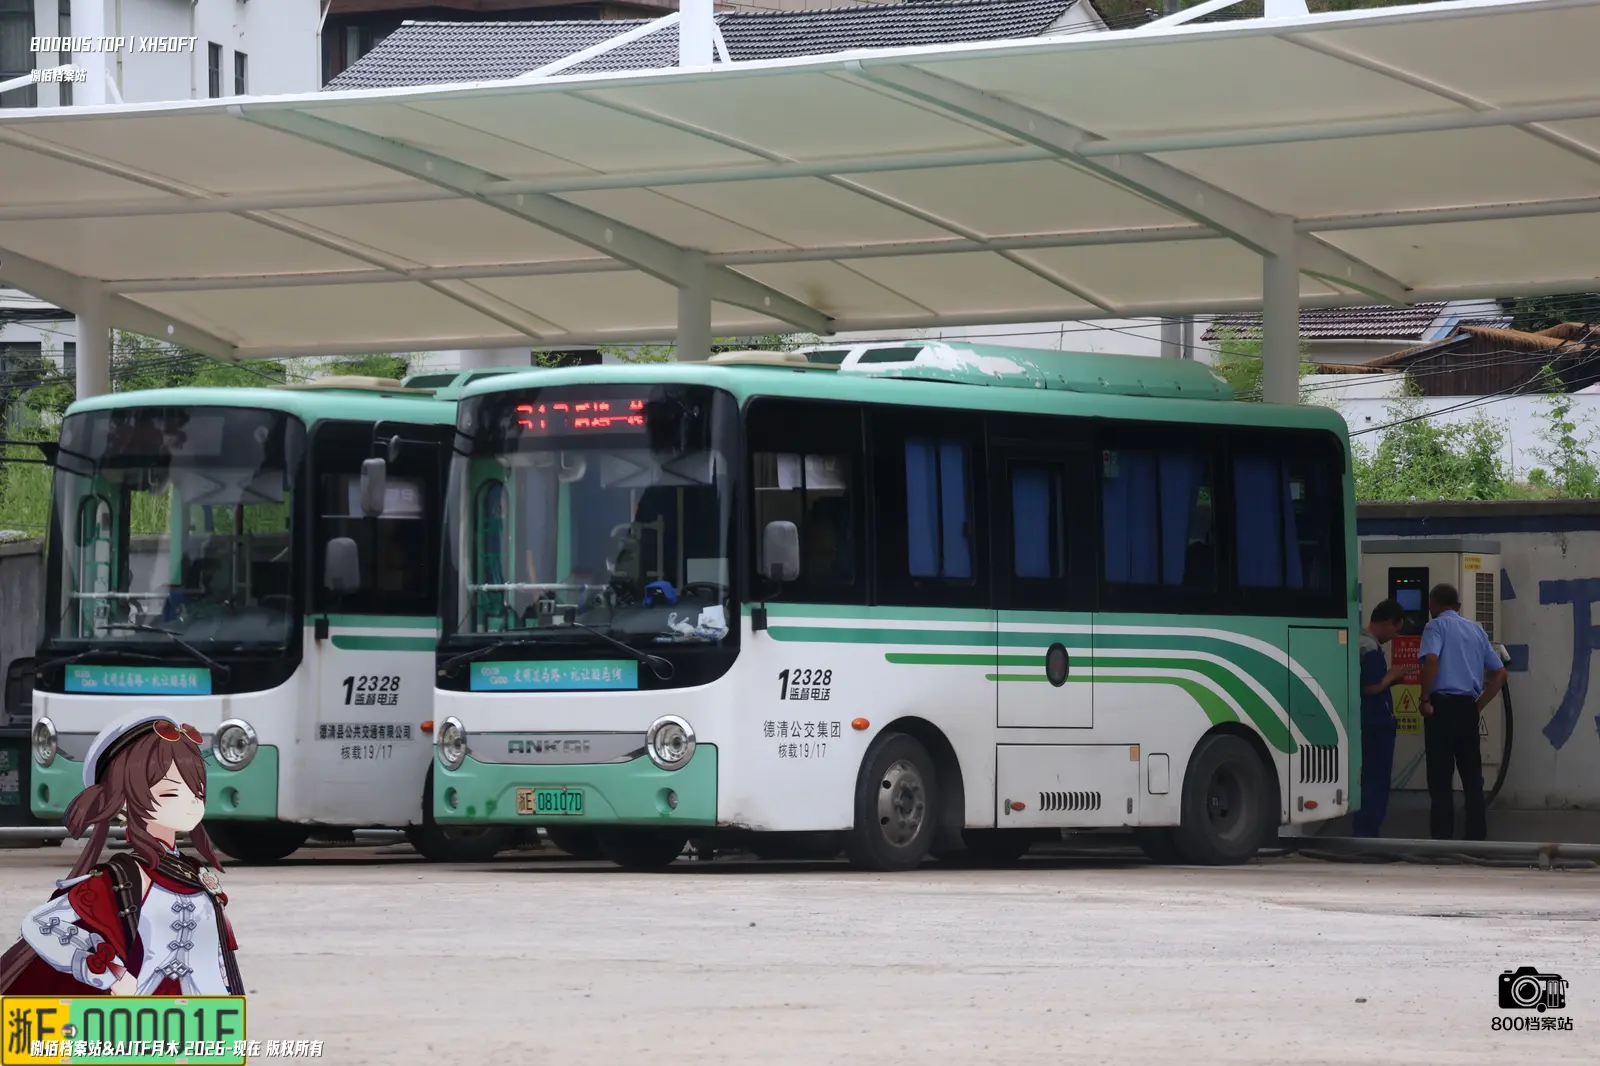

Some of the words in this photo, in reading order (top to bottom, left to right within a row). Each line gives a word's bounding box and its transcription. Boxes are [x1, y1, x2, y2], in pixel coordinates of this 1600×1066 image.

[342, 675, 401, 705] 12328
[778, 668, 833, 700] 12328
[354, 693, 398, 705] 监督电话
[789, 687, 831, 701] 监督电话
[319, 724, 411, 739] 德清县公共交通有限公司
[763, 720, 841, 738] 德清公交集团
[341, 744, 393, 760] 核载19/17
[508, 740, 591, 754] ANKAI
[778, 743, 827, 759] 核载19/17
